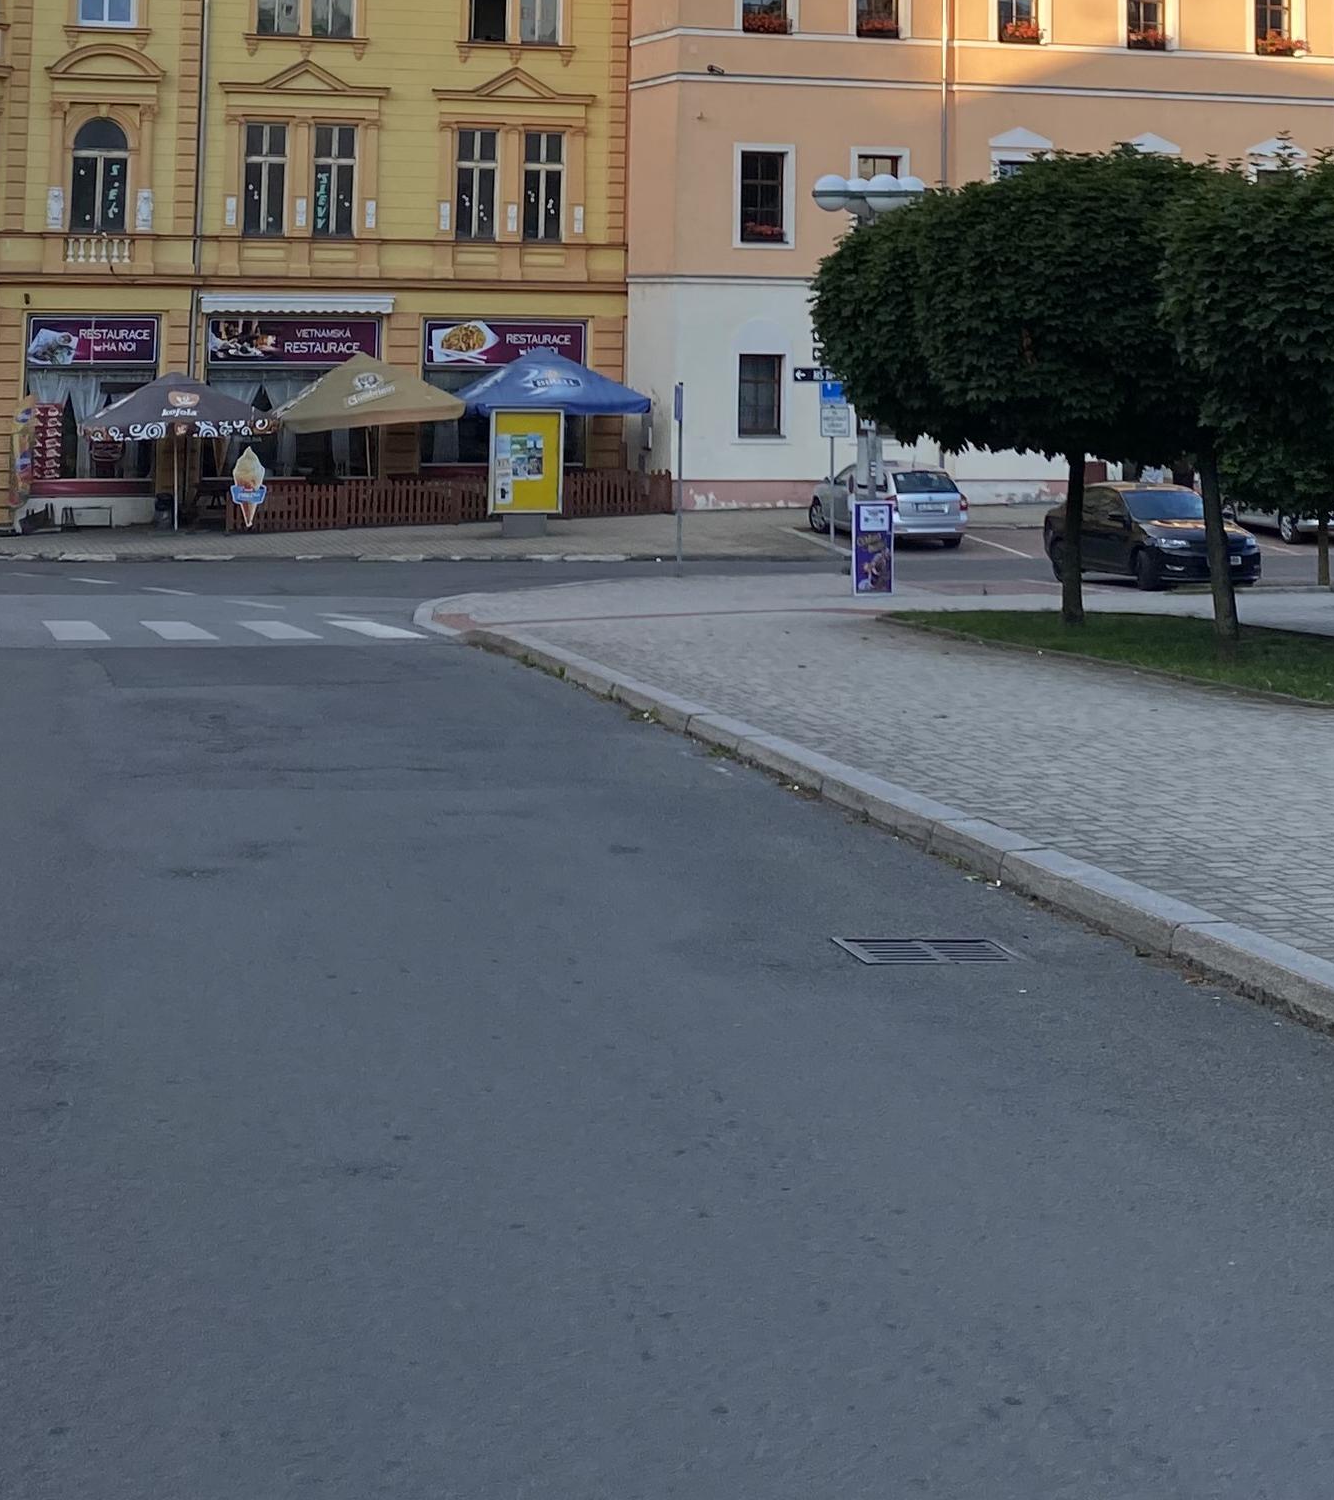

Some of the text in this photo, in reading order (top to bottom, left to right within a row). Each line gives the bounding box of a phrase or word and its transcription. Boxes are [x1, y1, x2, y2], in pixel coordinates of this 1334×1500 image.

[78, 329, 151, 340] RESTAURACE
[295, 327, 352, 338] VIETNAMSKÁ
[506, 333, 572, 345] RESTAURACE
[118, 342, 136, 352] NOI
[283, 341, 361, 354] RESTAURACE
